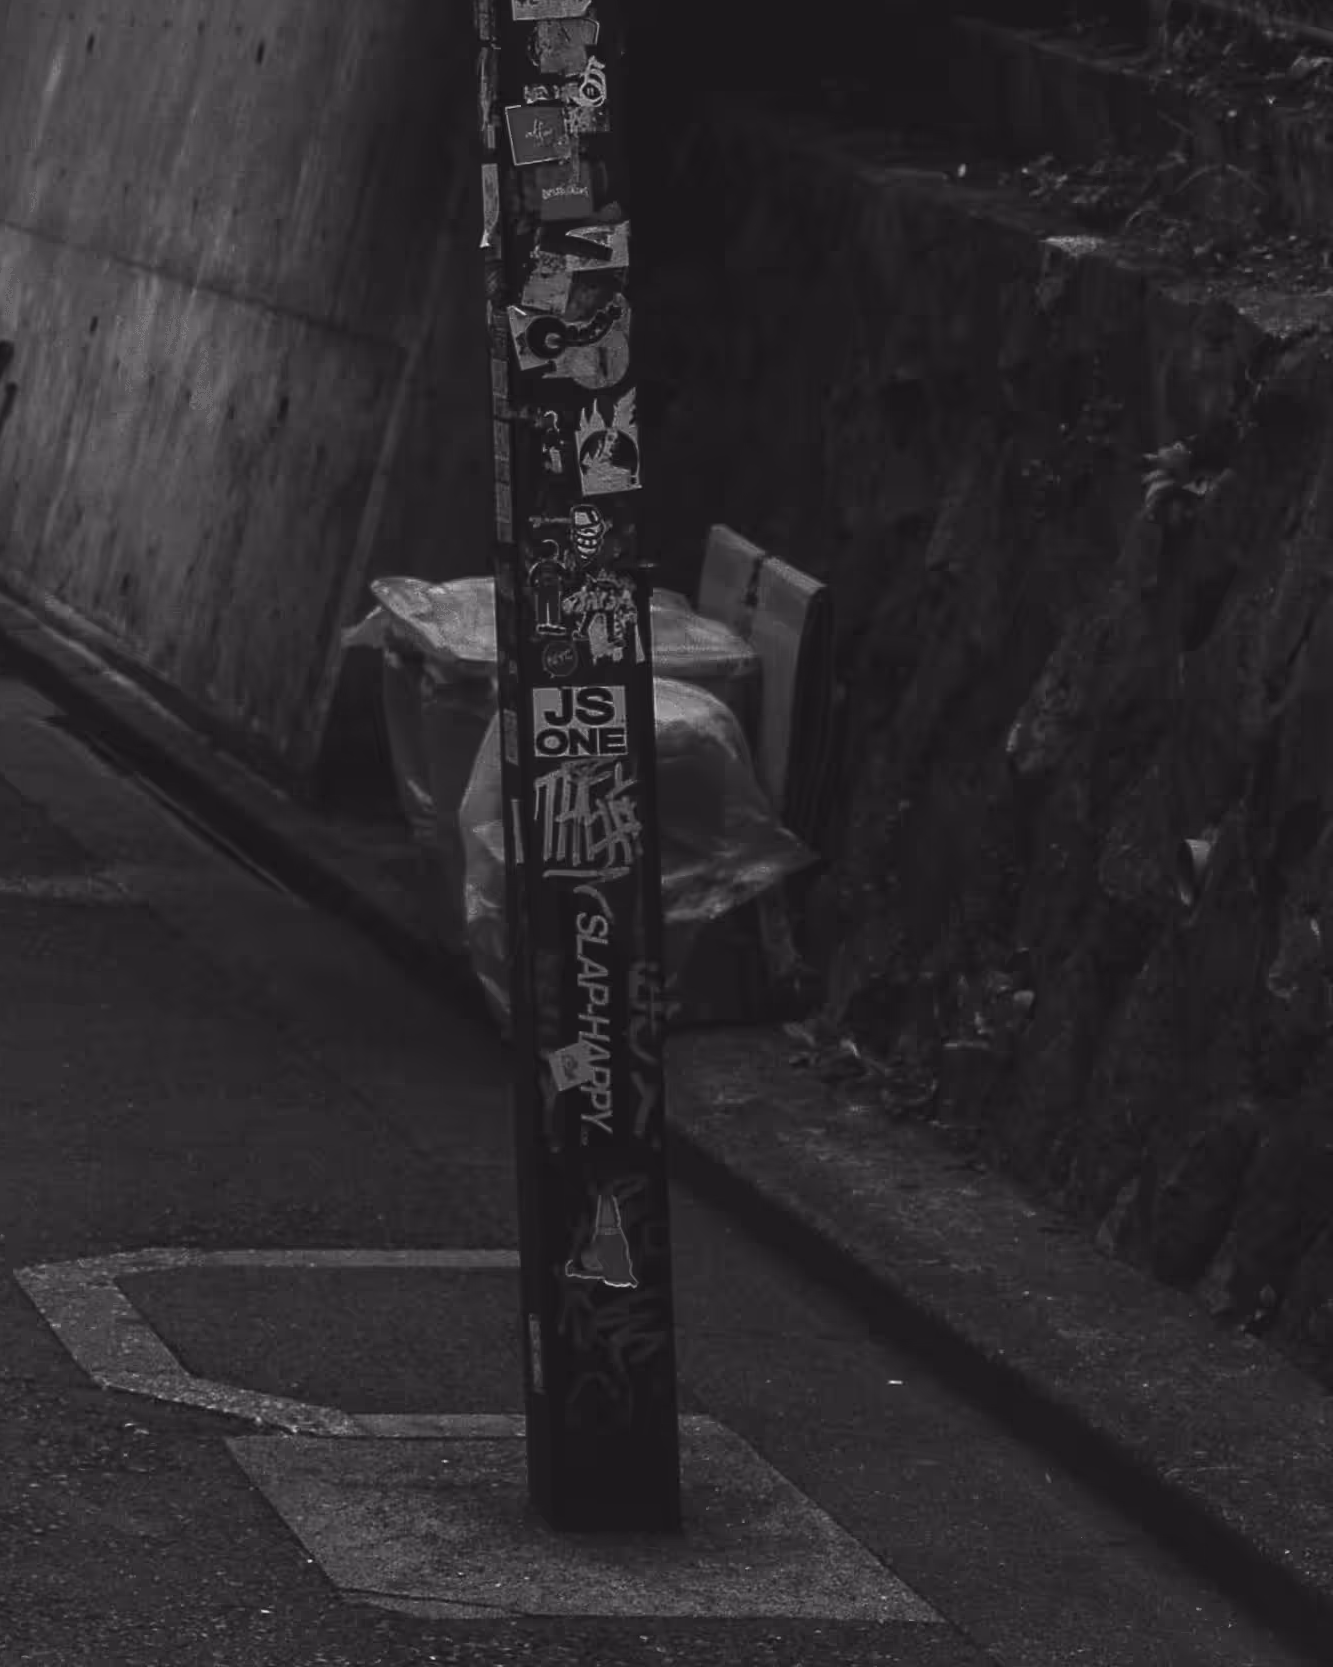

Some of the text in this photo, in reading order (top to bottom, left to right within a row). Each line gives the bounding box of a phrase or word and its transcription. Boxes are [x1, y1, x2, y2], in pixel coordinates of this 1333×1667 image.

[544, 686, 615, 727] JS
[536, 727, 627, 756] ONE
[575, 912, 614, 1134] SLAP-HAPPY
